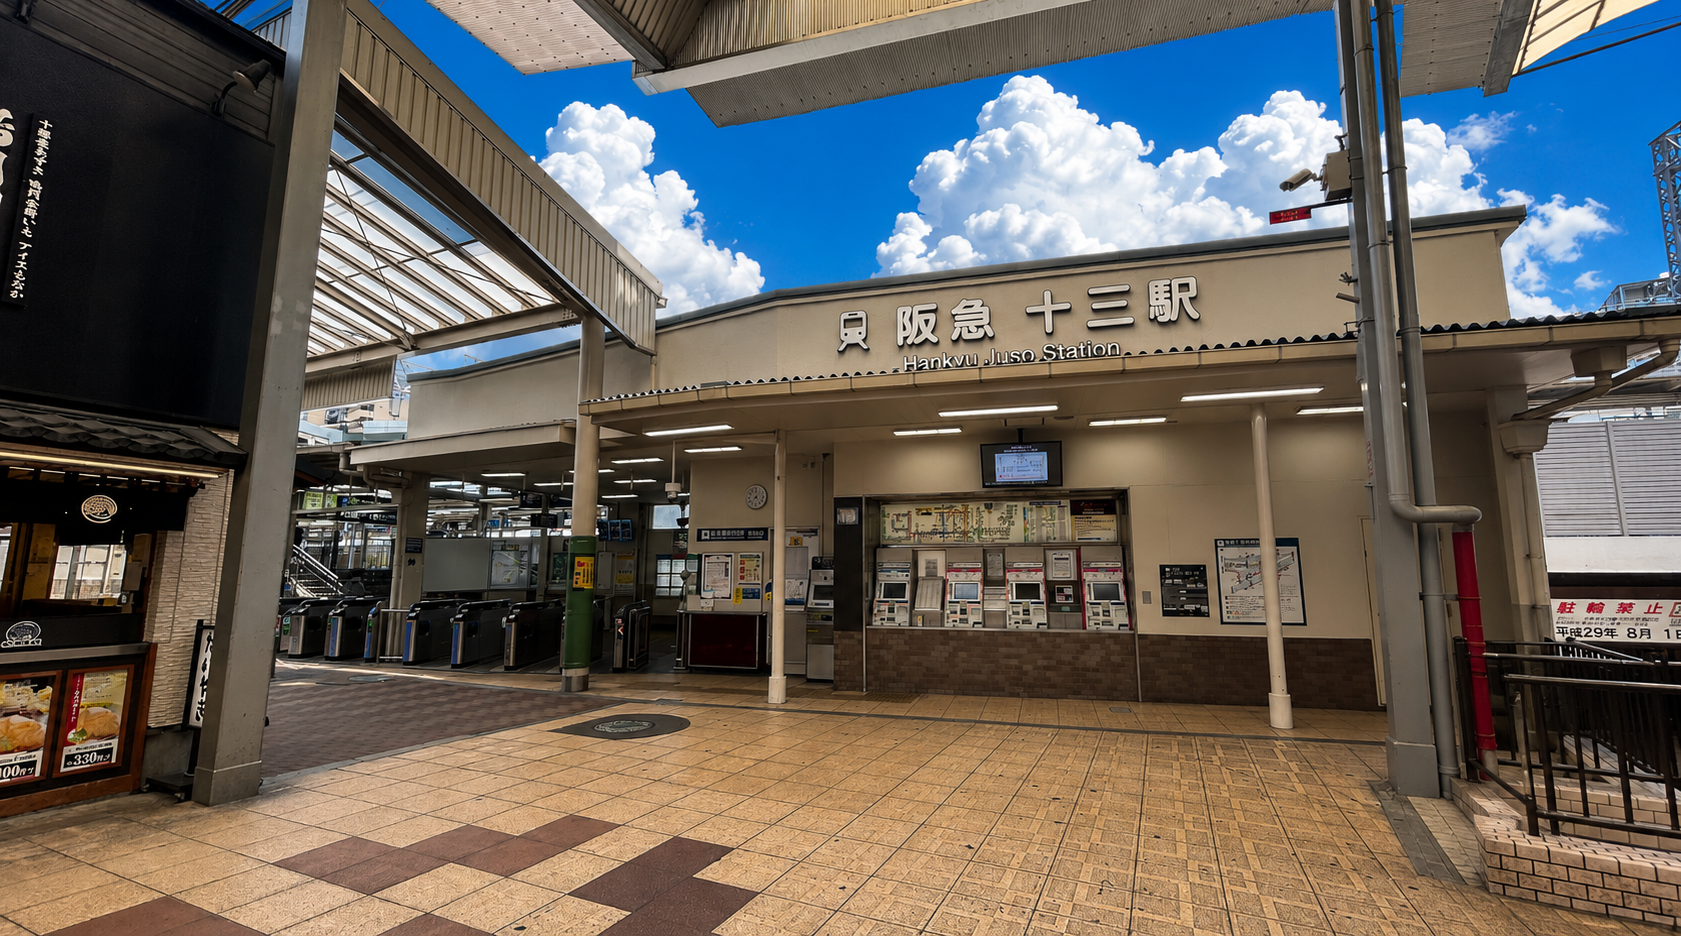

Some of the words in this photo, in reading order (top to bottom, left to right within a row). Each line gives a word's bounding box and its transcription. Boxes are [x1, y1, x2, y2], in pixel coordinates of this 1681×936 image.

[895, 298, 995, 347] 阪急
[1025, 275, 1201, 335] 十三駅
[1043, 340, 1120, 361] Station
